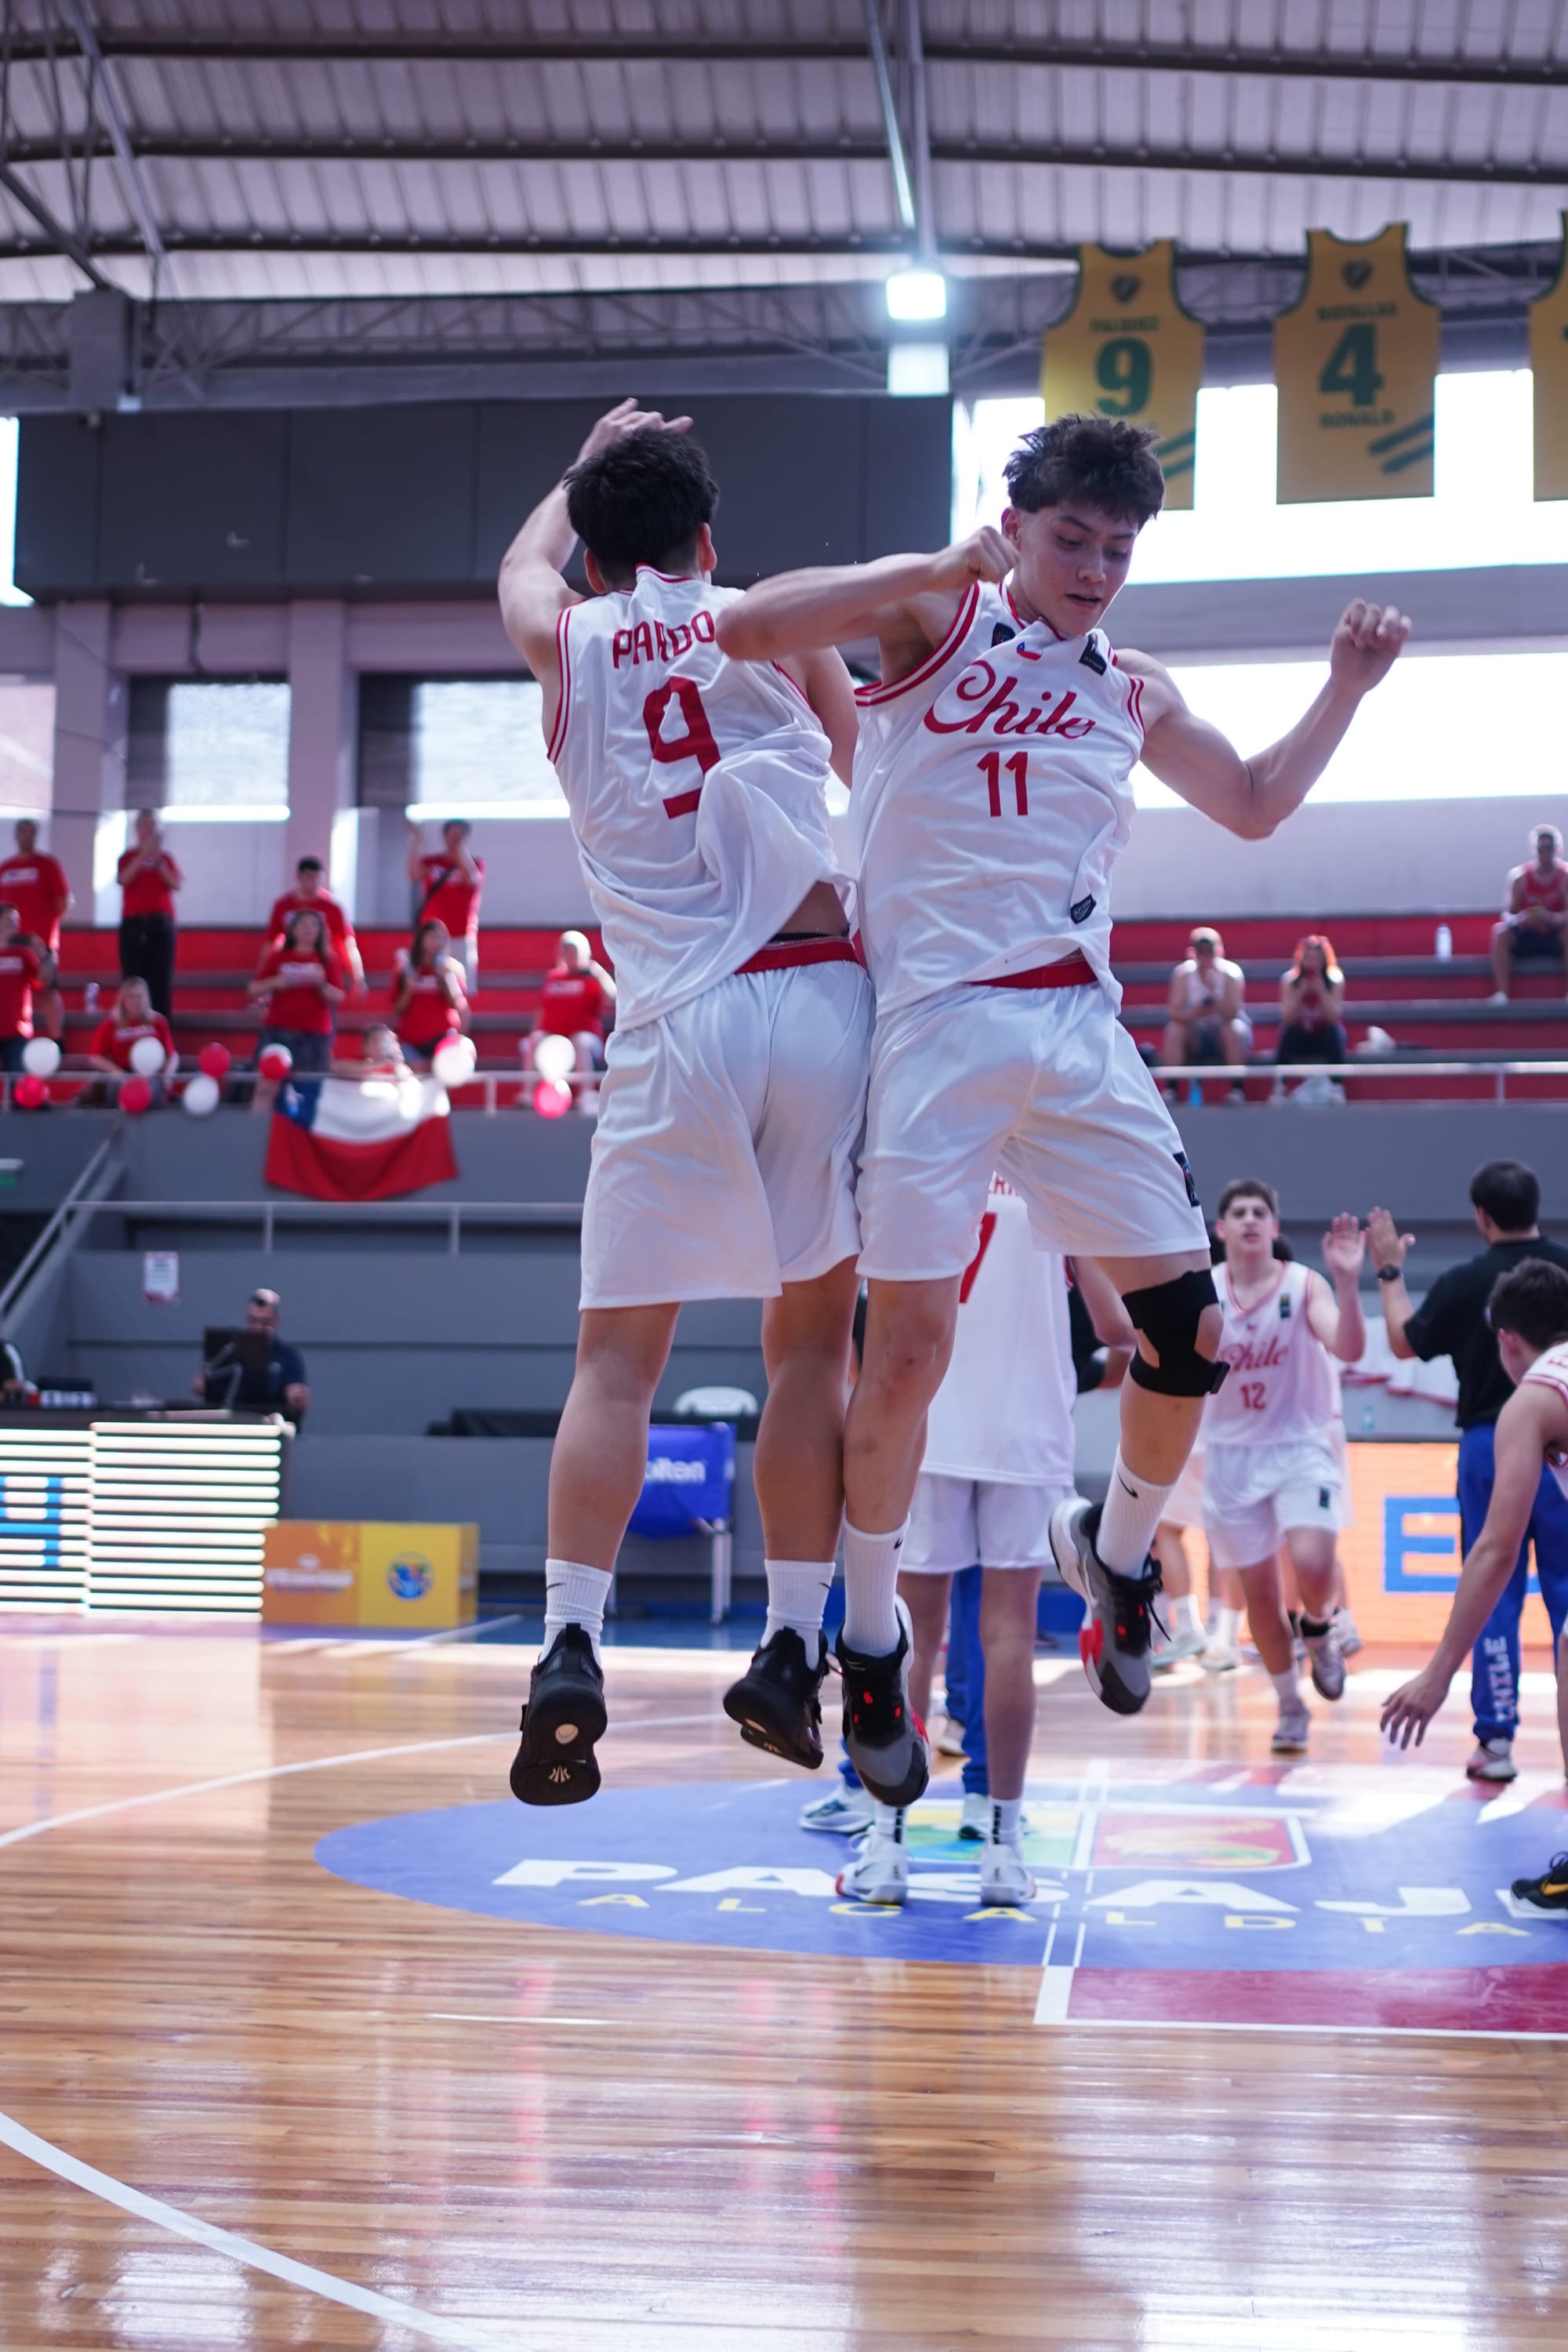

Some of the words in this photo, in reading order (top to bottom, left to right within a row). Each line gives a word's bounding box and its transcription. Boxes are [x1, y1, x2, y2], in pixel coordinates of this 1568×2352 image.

[1095, 337, 1152, 417] 9
[1320, 324, 1384, 405] 4
[613, 610, 715, 669] PARDO
[924, 659, 1096, 739] Chile
[643, 676, 720, 819] 9
[976, 751, 1029, 817] 11
[1240, 1382, 1265, 1410] 12
